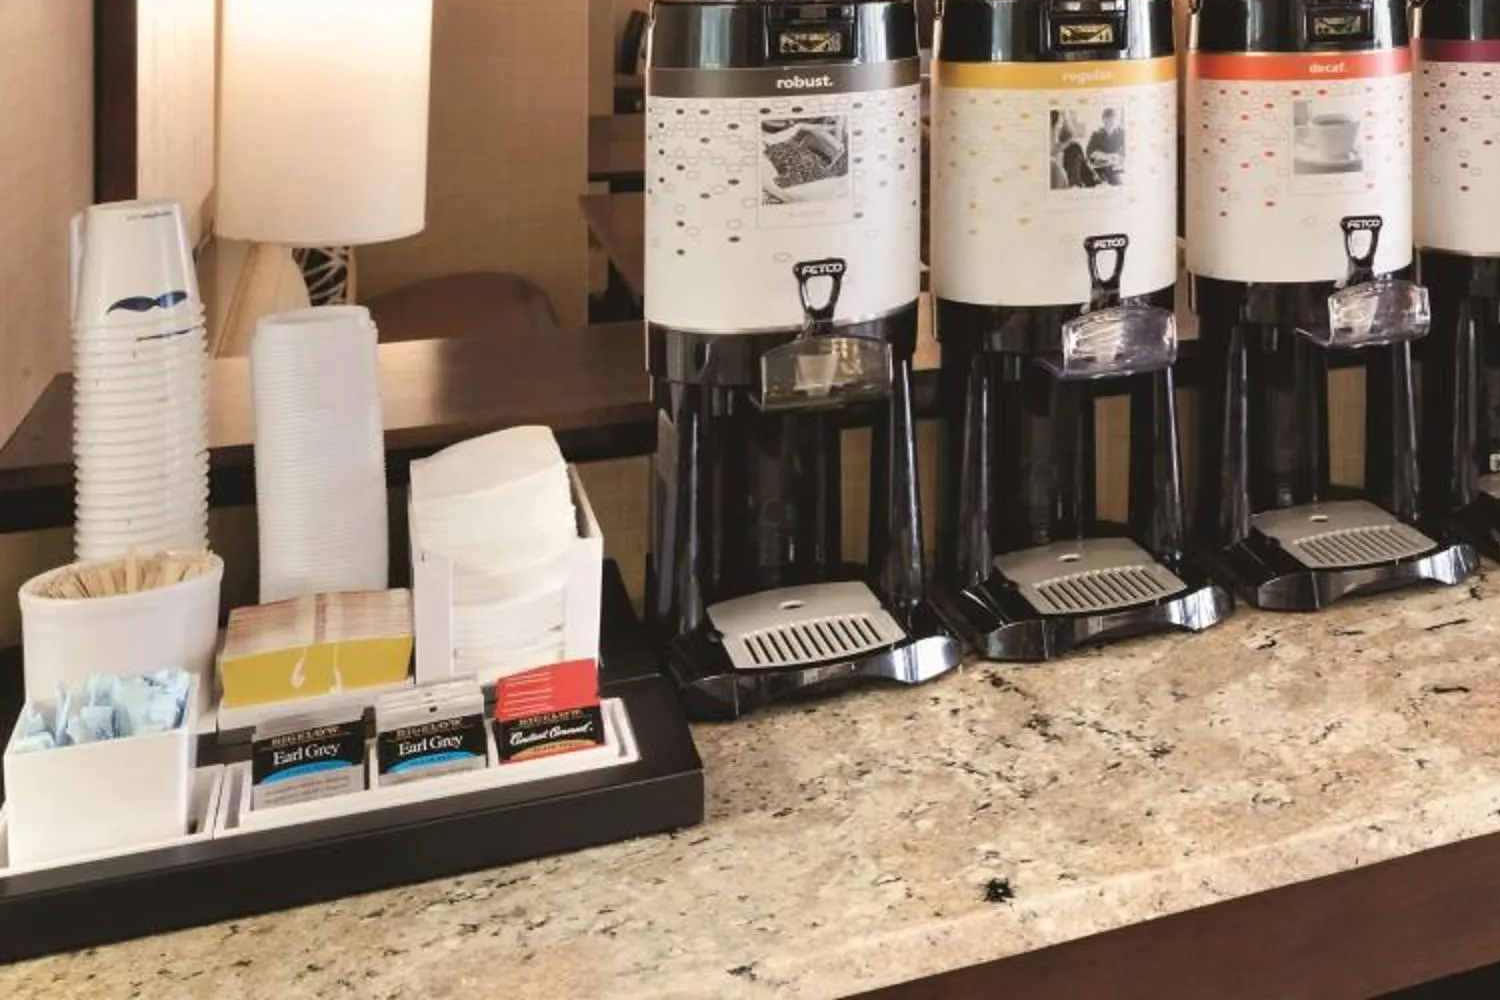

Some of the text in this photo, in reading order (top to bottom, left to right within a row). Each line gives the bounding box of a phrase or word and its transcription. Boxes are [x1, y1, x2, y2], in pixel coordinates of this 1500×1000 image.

[776, 74, 834, 89] robust.
[1347, 219, 1380, 229] FETCO
[1093, 238, 1126, 249] FETCO
[802, 263, 843, 275] FETCO
[398, 735, 463, 756] Earl Grey
[273, 743, 340, 766] Earl Grey
